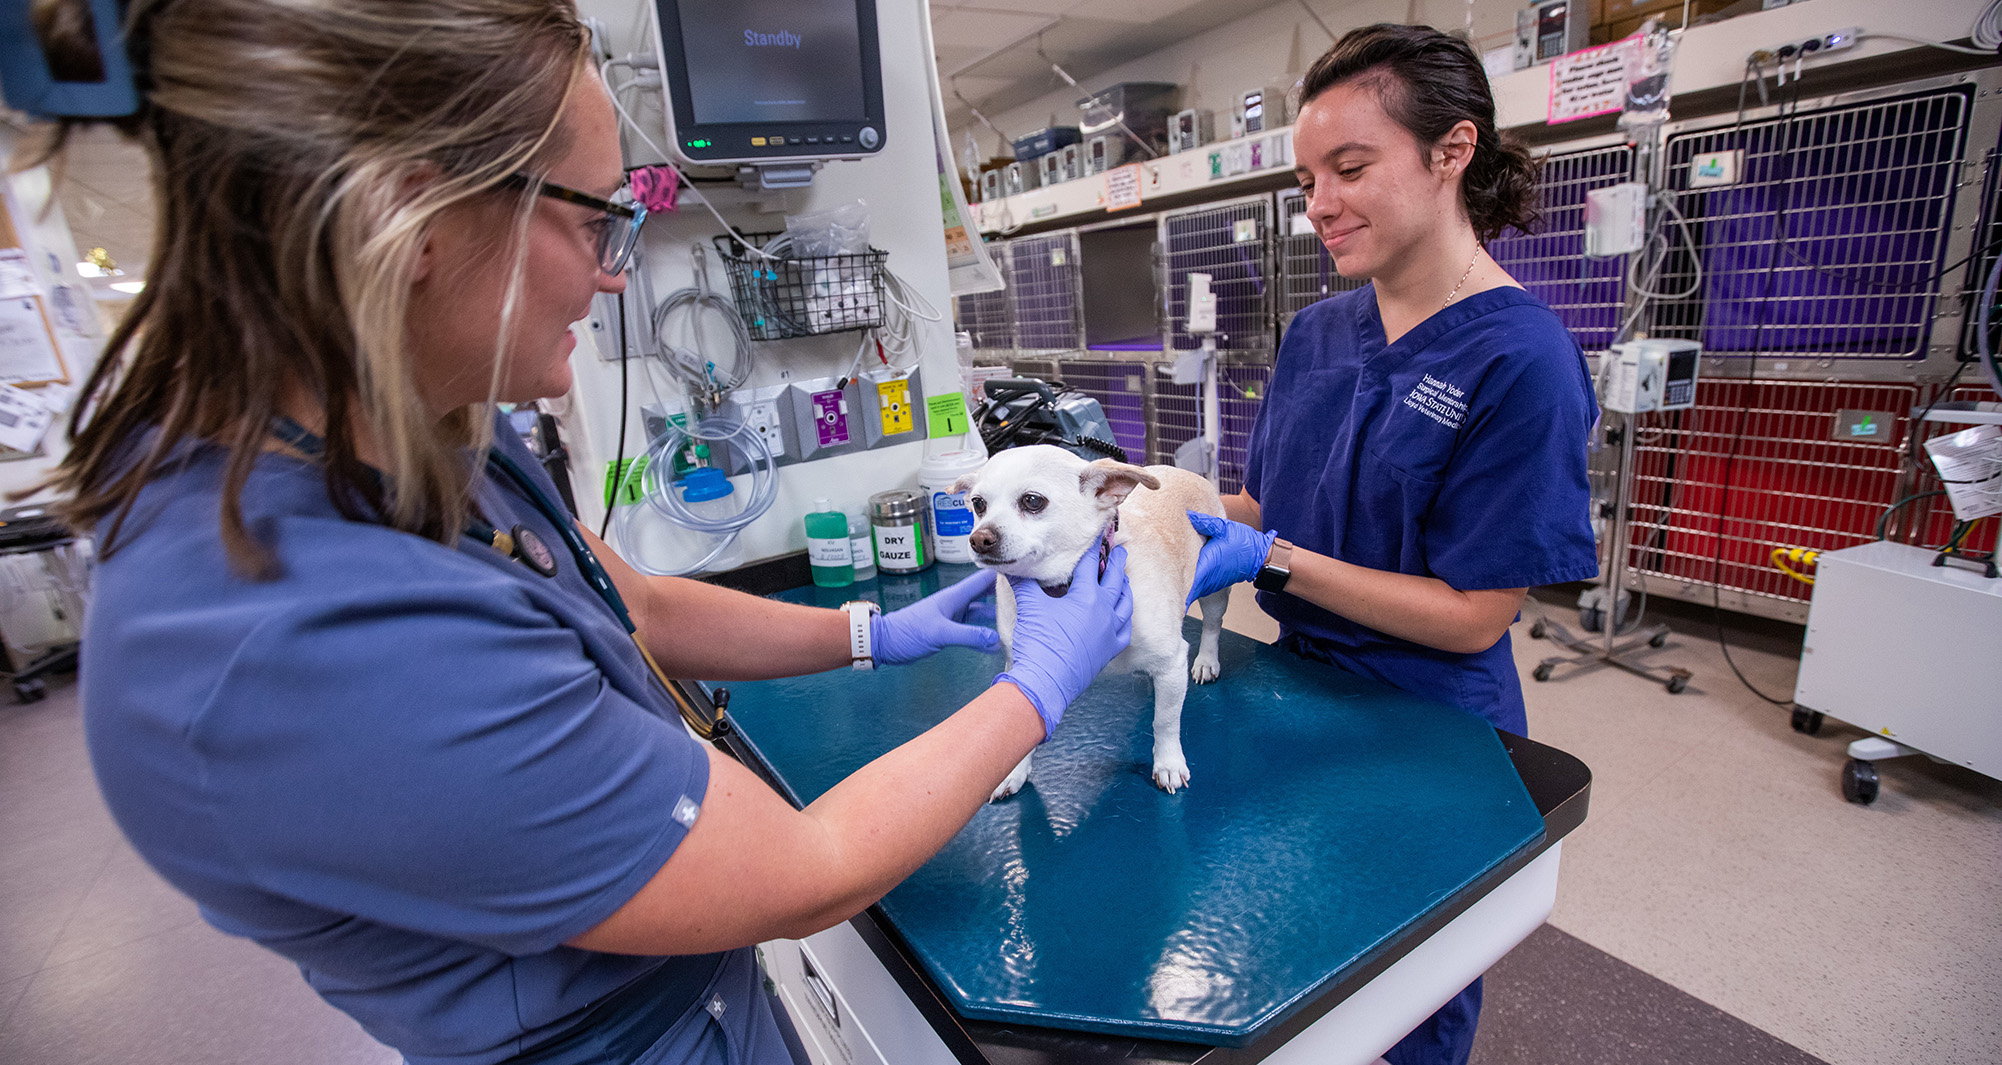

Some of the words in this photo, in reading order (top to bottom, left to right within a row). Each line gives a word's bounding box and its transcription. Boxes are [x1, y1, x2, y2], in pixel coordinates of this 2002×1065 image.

[744, 28, 801, 49] Standby
[1417, 382, 1439, 397] Surgical
[1422, 373, 1447, 390] Hannah
[1446, 384, 1464, 398] Yoder
[1404, 397, 1419, 408] Lloyd
[1417, 404, 1443, 423] Veterinary
[1409, 389, 1427, 404] IOWA
[1426, 398, 1446, 414] STATE
[937, 498, 964, 507] RESCU
[880, 551, 911, 559] GAUZE
